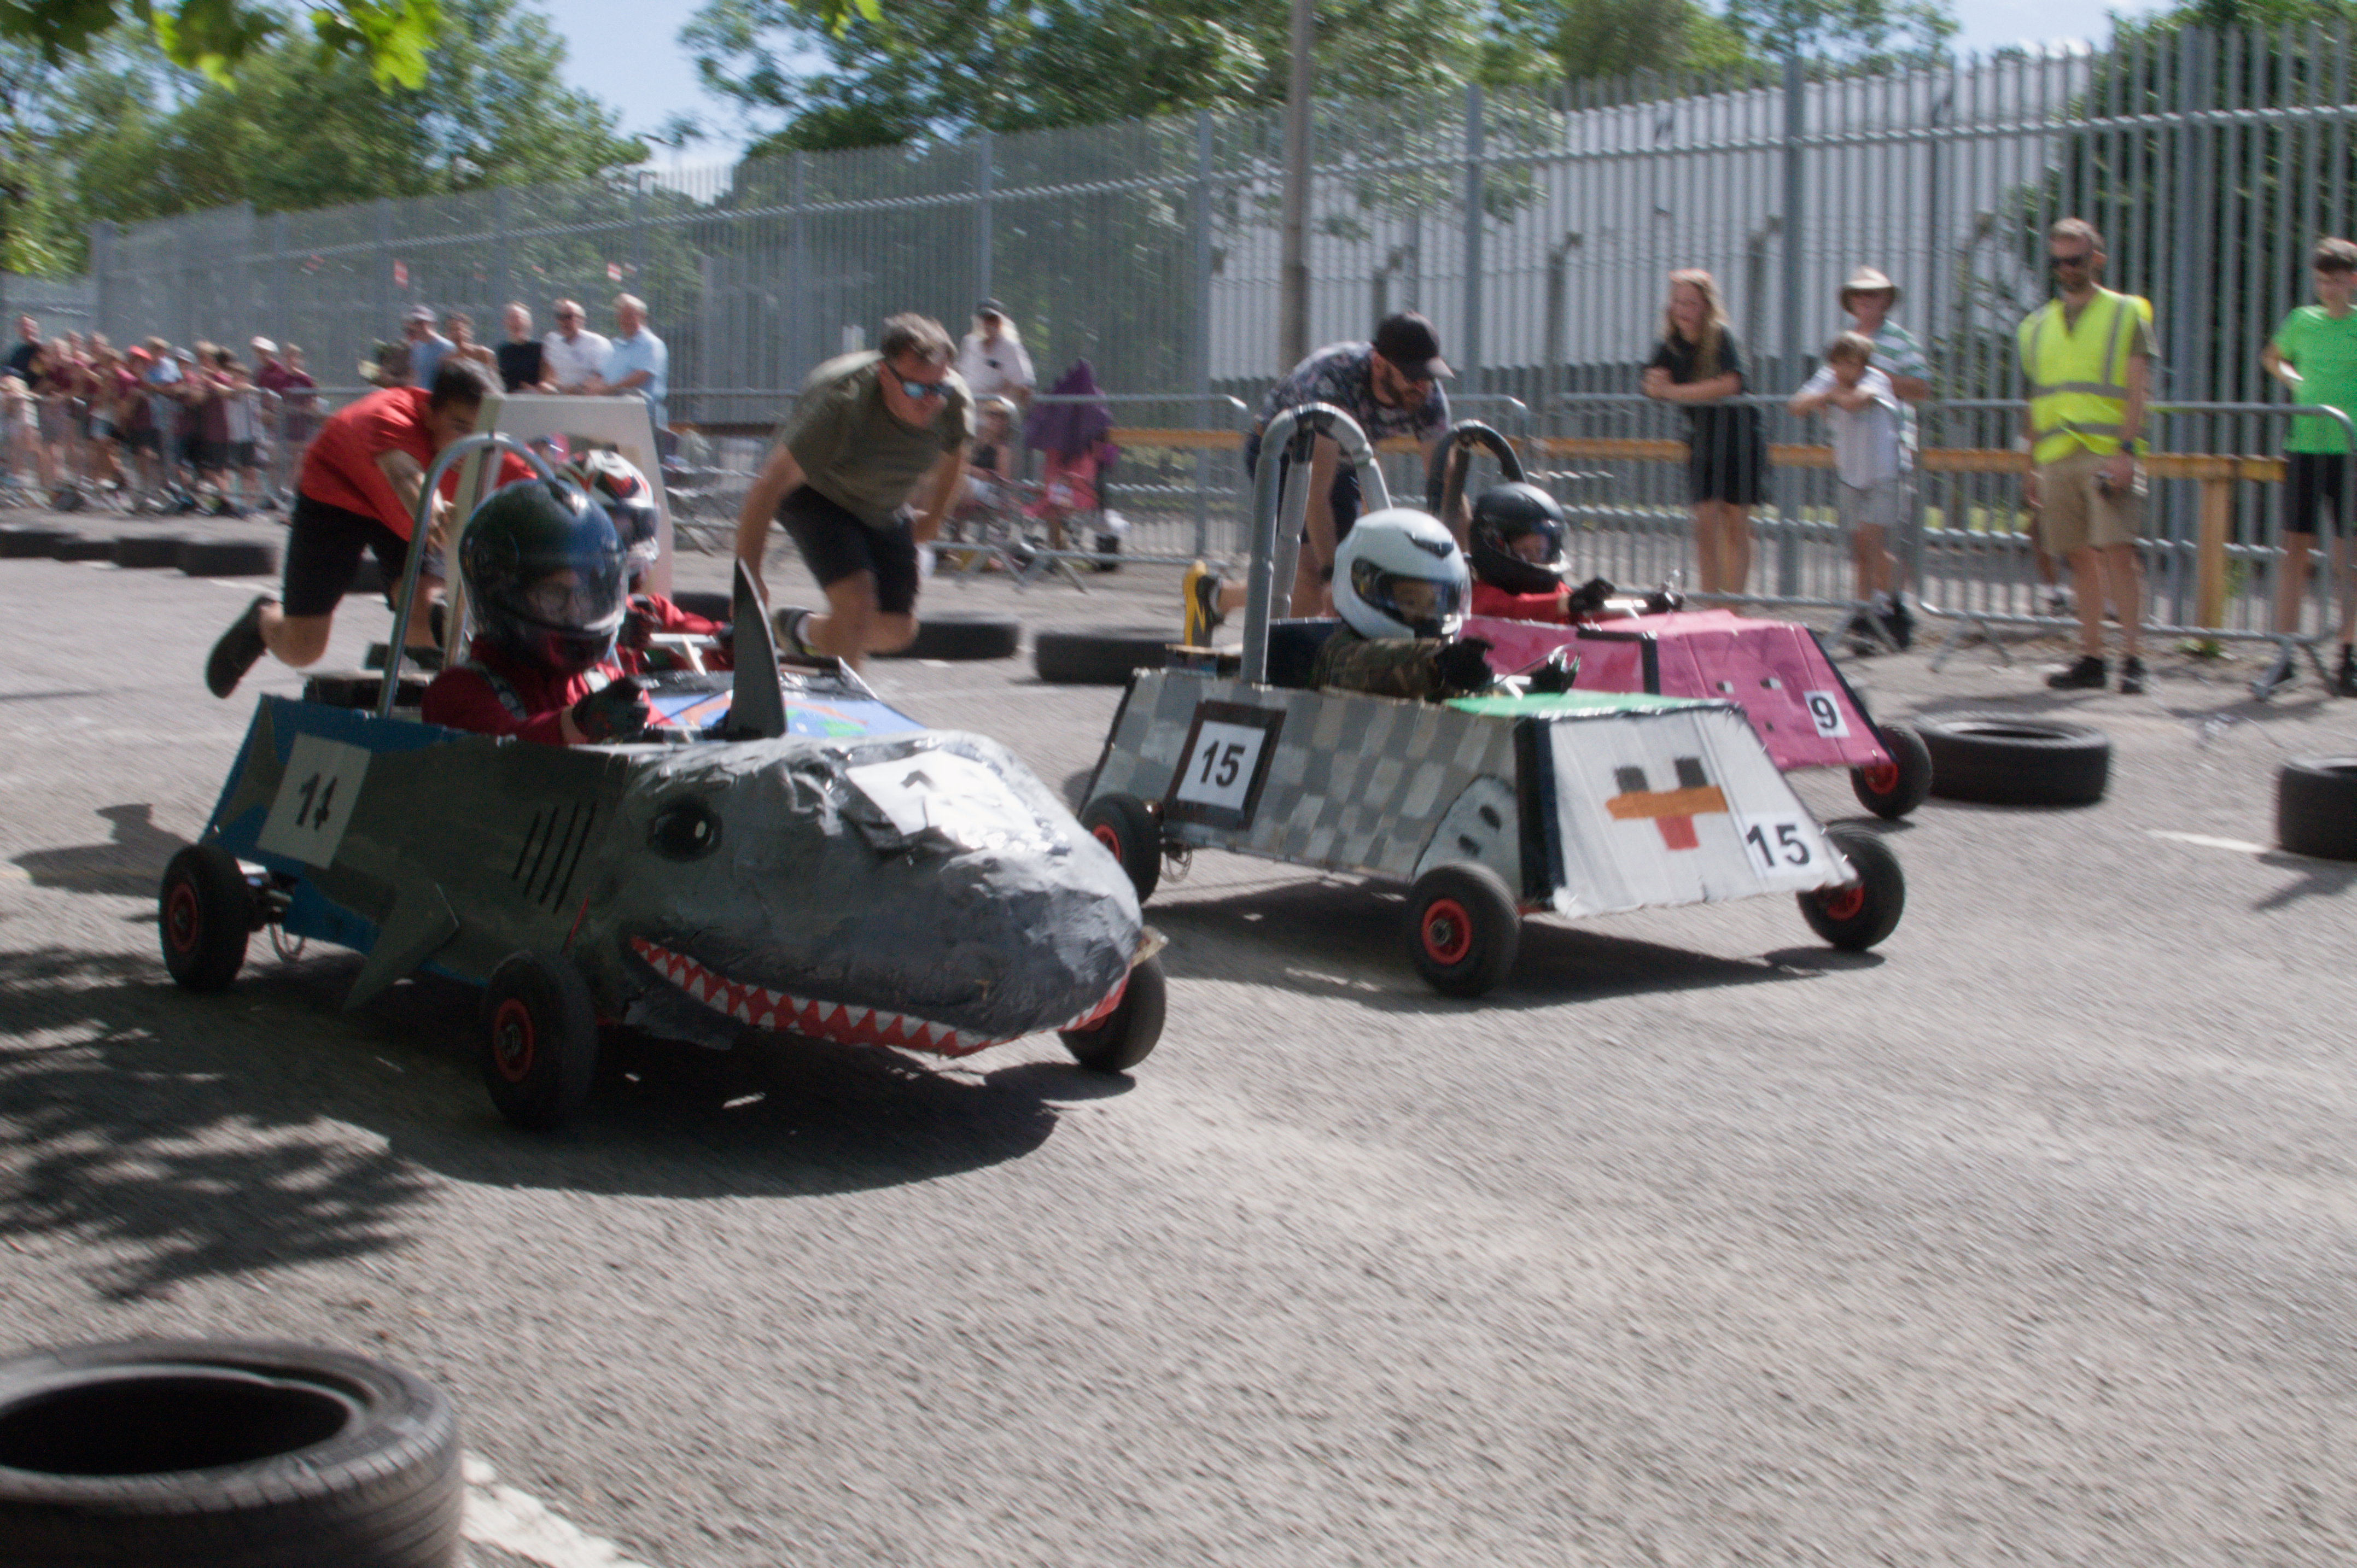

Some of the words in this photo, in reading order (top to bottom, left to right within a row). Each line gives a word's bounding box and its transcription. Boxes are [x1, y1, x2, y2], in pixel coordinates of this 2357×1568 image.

[1811, 695, 1838, 729] 9
[1200, 740, 1246, 787] 15
[1747, 823, 1810, 867] 15
